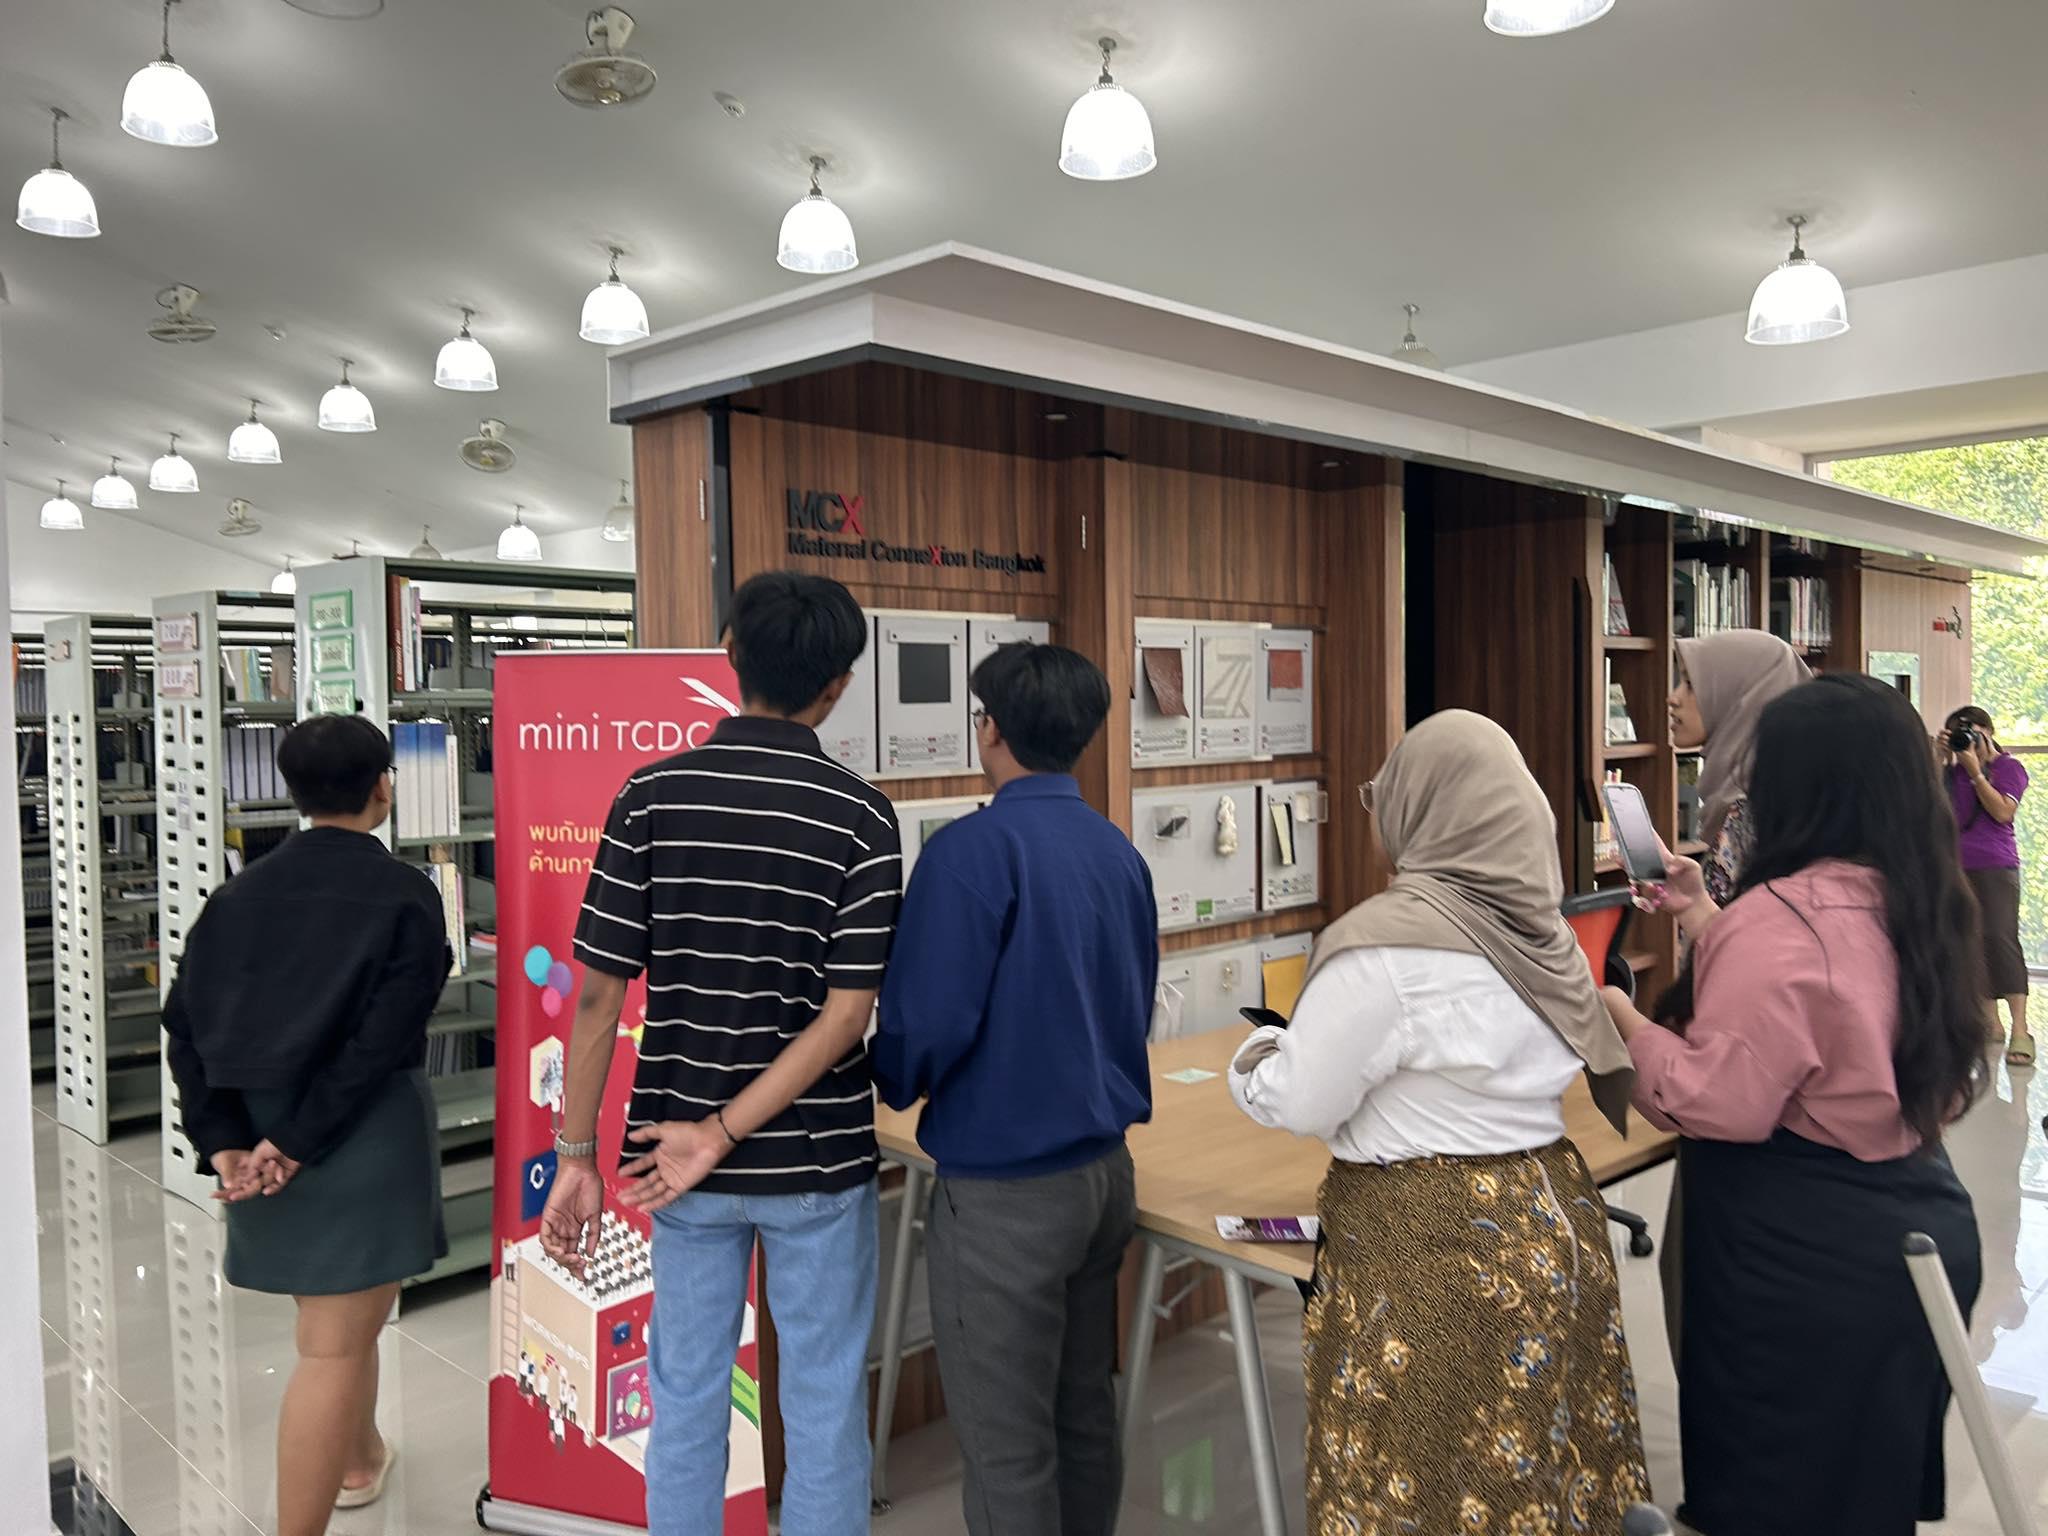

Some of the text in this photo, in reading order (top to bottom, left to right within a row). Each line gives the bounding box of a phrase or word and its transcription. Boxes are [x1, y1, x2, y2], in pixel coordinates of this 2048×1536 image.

[787, 489, 865, 537] MCX
[788, 532, 1046, 576] Material ConneXion Bangkok
[519, 712, 710, 752] mini TCDC
[528, 820, 604, 844] พบกับแ
